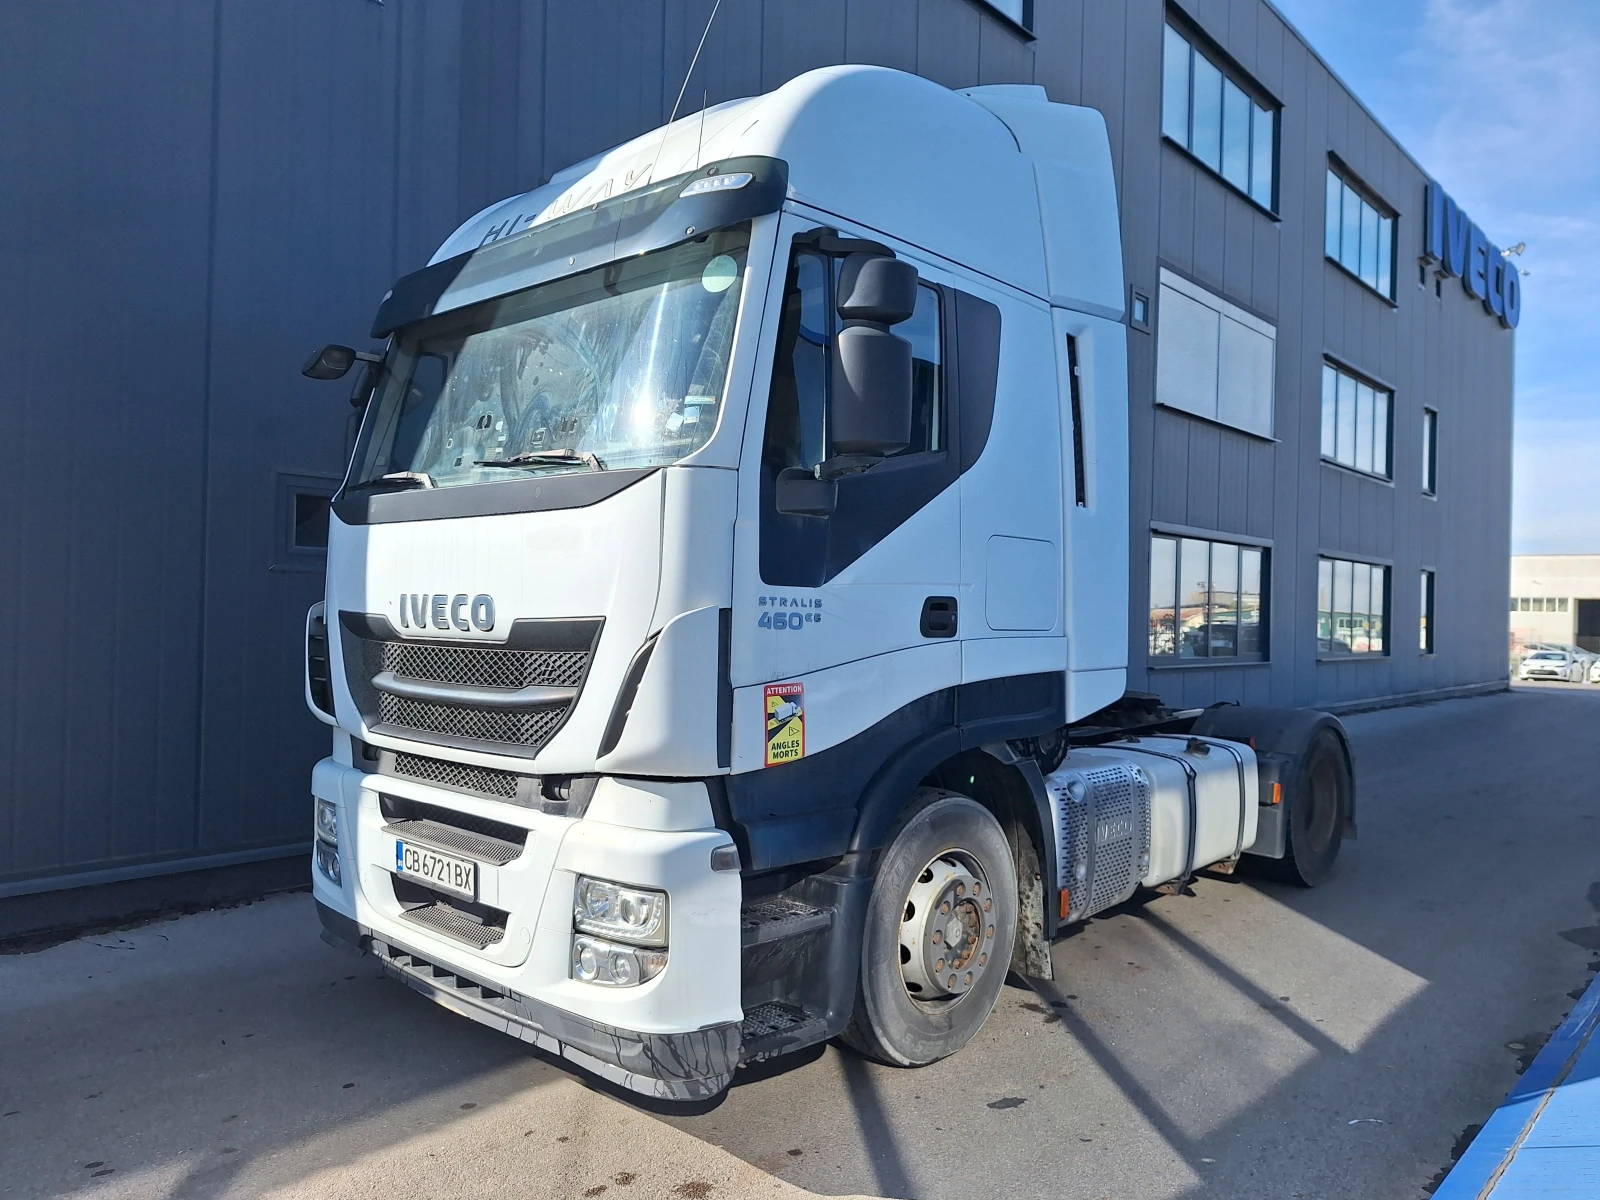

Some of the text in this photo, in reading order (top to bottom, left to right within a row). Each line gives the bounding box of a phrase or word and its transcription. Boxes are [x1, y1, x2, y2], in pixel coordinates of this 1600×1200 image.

[1425, 180, 1521, 329] IVECO
[758, 596, 823, 608] STRALIS
[400, 593, 496, 632] IVECO
[766, 685, 802, 695] ATTENTION
[771, 740, 800, 751] ANGLES
[772, 749, 799, 760] MORTS
[1094, 817, 1133, 843] IVECO
